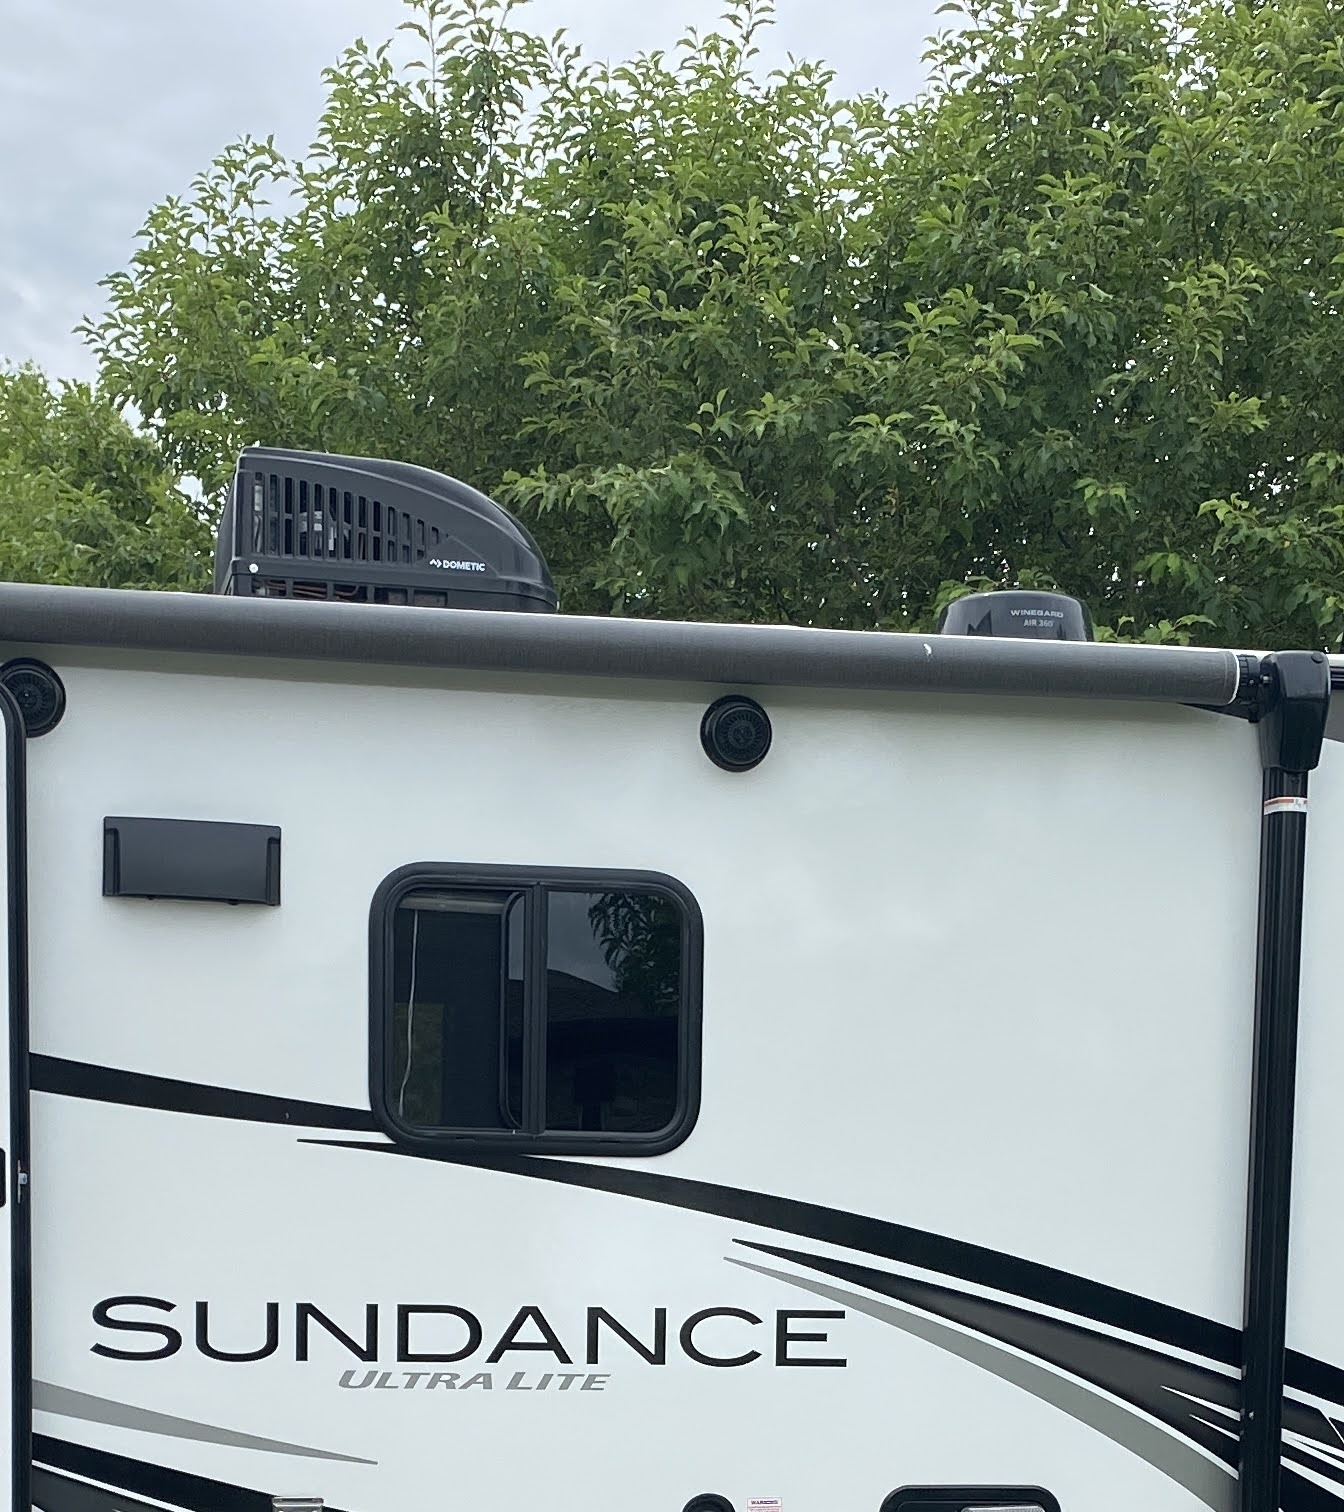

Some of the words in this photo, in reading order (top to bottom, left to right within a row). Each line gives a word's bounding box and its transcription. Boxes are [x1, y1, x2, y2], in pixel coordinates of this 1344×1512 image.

[443, 559, 486, 572] DOMETIC
[1010, 609, 1064, 619] WINEGARD
[1023, 618, 1037, 627] AIR
[89, 1295, 847, 1368] SUNDANCE
[338, 1369, 497, 1392] ULTRA
[504, 1370, 612, 1392] LITE
